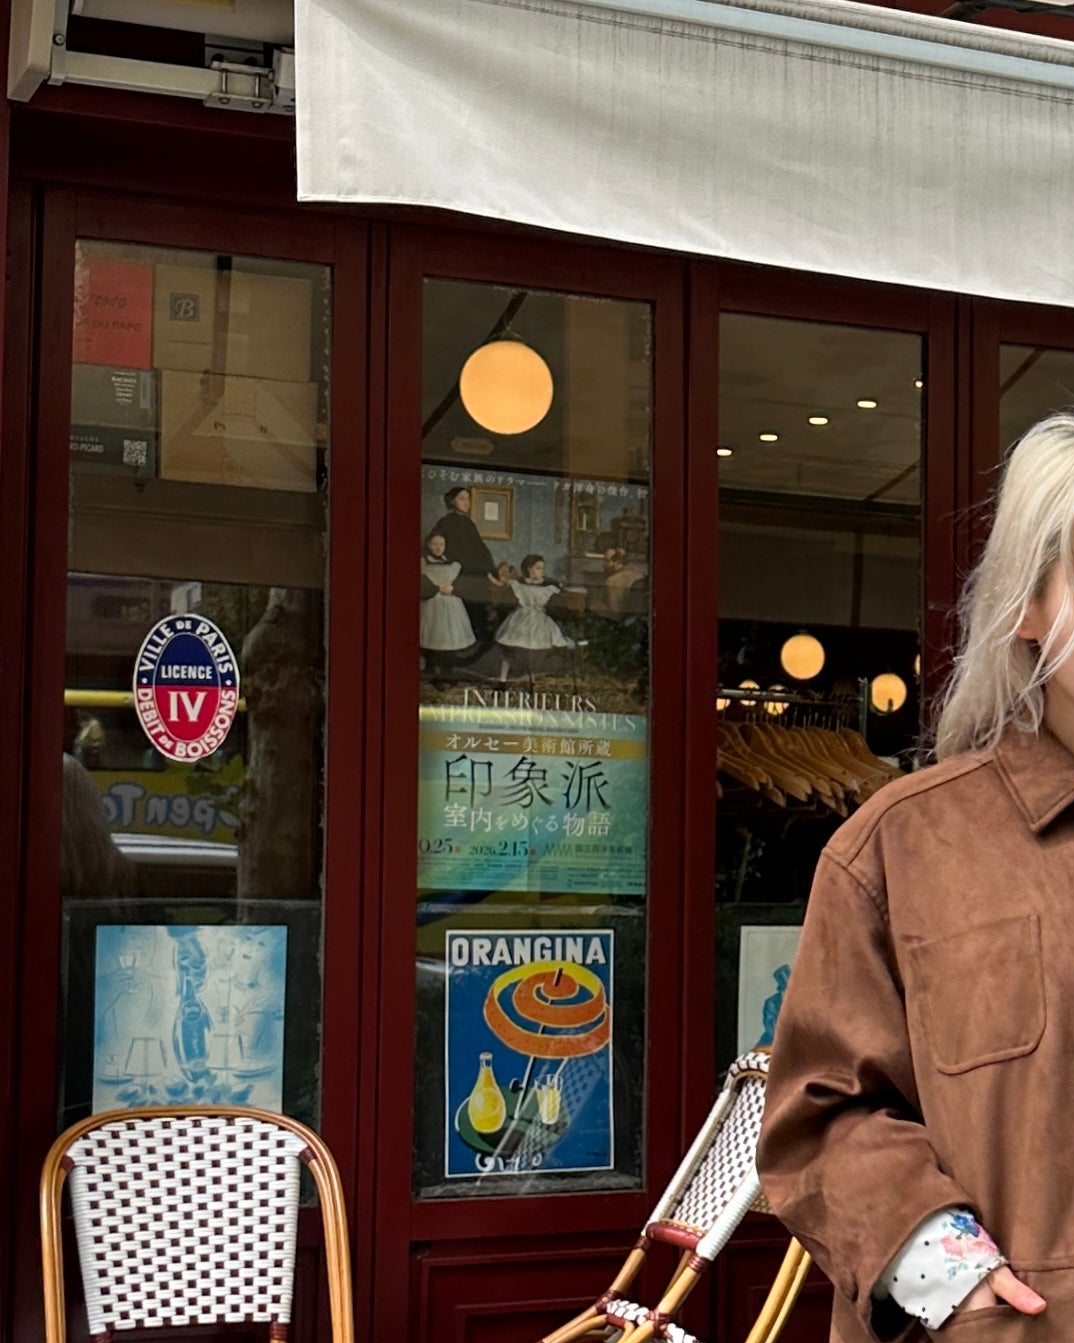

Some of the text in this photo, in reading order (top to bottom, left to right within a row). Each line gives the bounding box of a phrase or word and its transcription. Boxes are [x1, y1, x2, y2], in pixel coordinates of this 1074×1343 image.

[139, 620, 233, 674] VILLE DE PARIS
[161, 664, 213, 680] LICENCE
[137, 687, 236, 758] DEBIT DE BOISSONS
[168, 690, 207, 723] IV
[445, 732, 612, 757] オルセー美術館所蔵
[444, 753, 613, 814] 印象派
[443, 802, 612, 837] 室内をめぐる物語
[451, 936, 606, 967] ORANGINA
